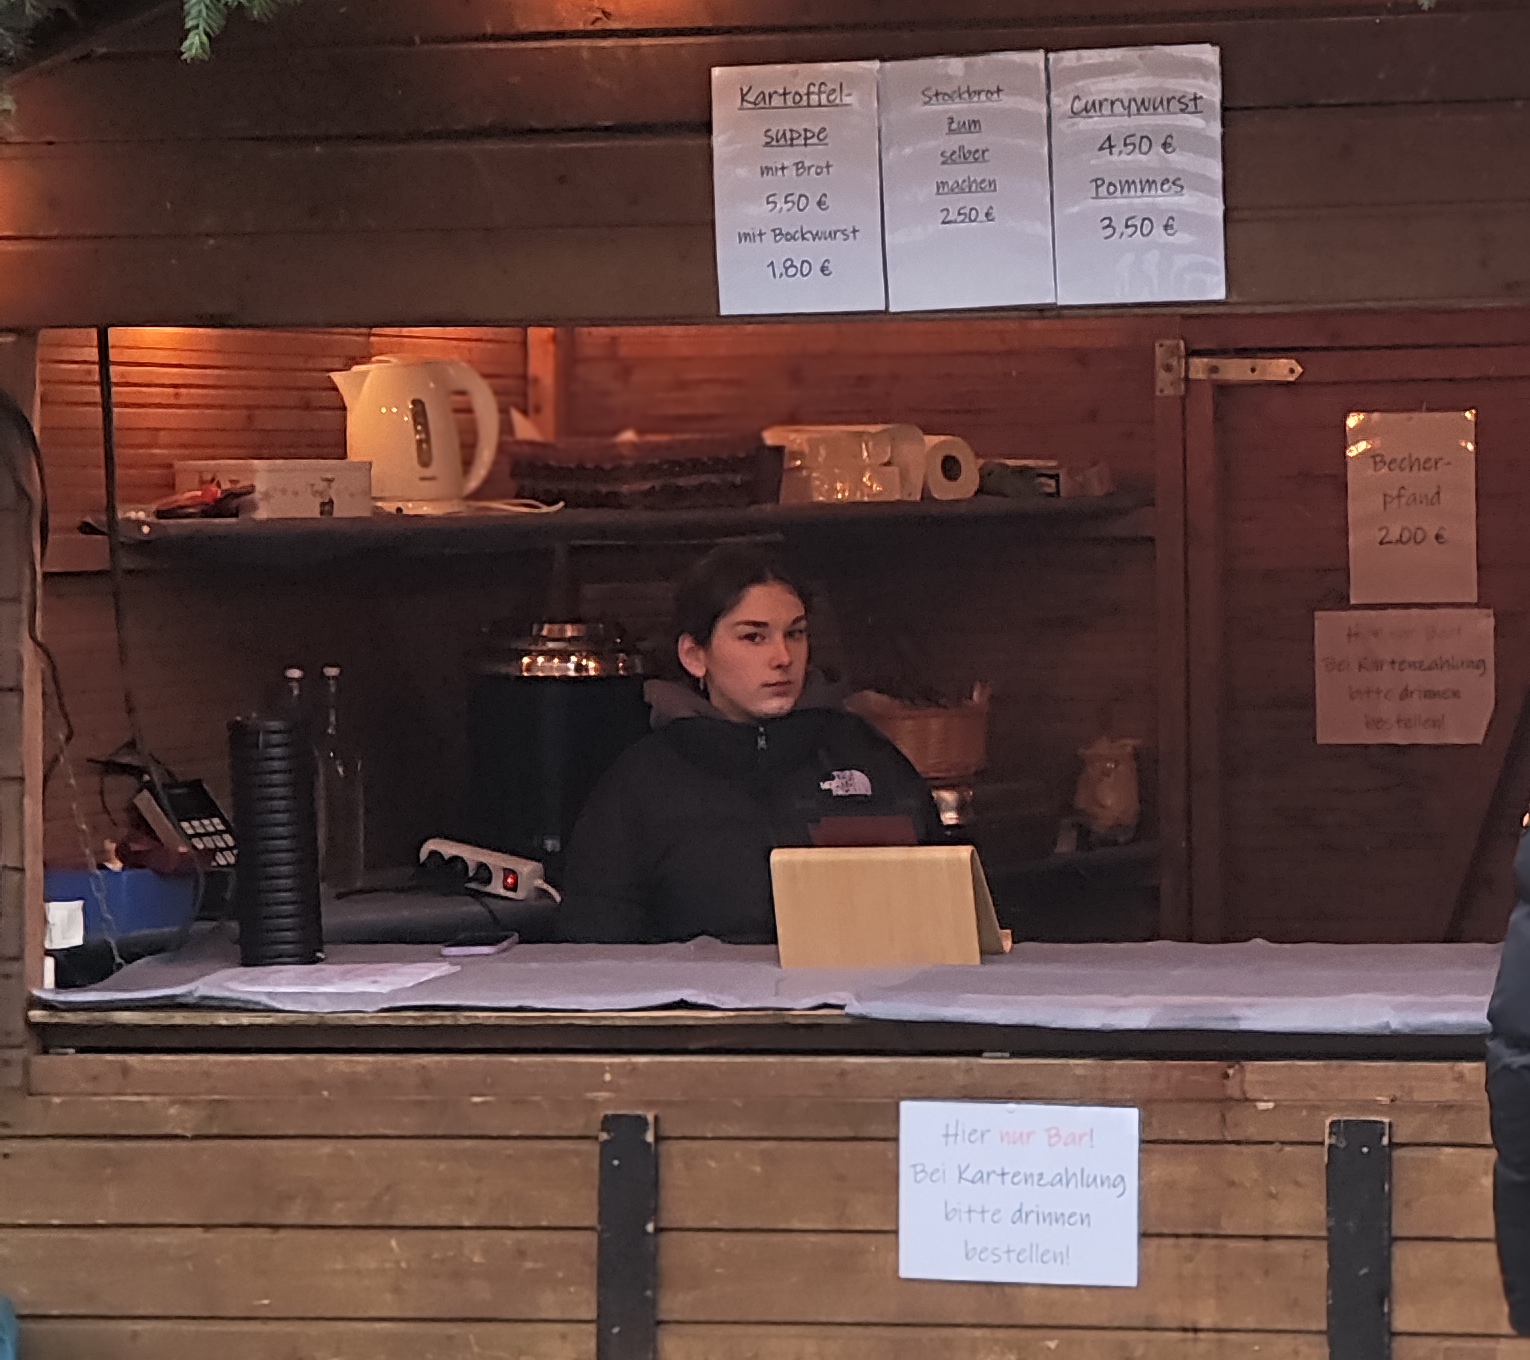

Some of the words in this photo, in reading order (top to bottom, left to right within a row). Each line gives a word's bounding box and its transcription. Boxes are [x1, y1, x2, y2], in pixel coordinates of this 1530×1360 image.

[739, 81, 853, 108] Kartoffel-
[921, 84, 1004, 105] Stockbrot
[1070, 92, 1204, 118] Currywurst
[763, 126, 829, 148] suppe
[1097, 133, 1153, 156] 4,50
[1161, 133, 1177, 154] €
[940, 144, 990, 163] selber
[760, 162, 788, 178] mit
[794, 160, 833, 177] Brot
[935, 174, 997, 194] machen
[1089, 176, 1186, 198] Pommes
[766, 192, 809, 214] 5,50
[816, 192, 830, 211] €
[984, 205, 996, 222] €
[737, 227, 766, 244] mit
[770, 224, 860, 244] Bockwurst
[1099, 215, 1154, 240] 3,50
[1163, 215, 1178, 237] €
[766, 257, 812, 279] 1,80
[819, 258, 833, 277] €
[1370, 452, 1452, 472] Becher-
[1382, 486, 1442, 511] pfand
[1434, 526, 1447, 545] €
[942, 1120, 991, 1147] Hier
[1000, 1130, 1036, 1146] nur
[1045, 1126, 1094, 1148] Bar!
[910, 1162, 946, 1185] Bei
[957, 1163, 1127, 1198] Kartenzahlung
[943, 1200, 1001, 1224] bitte
[1010, 1202, 1091, 1228] drinnen
[964, 1239, 1070, 1266] bestellen!
